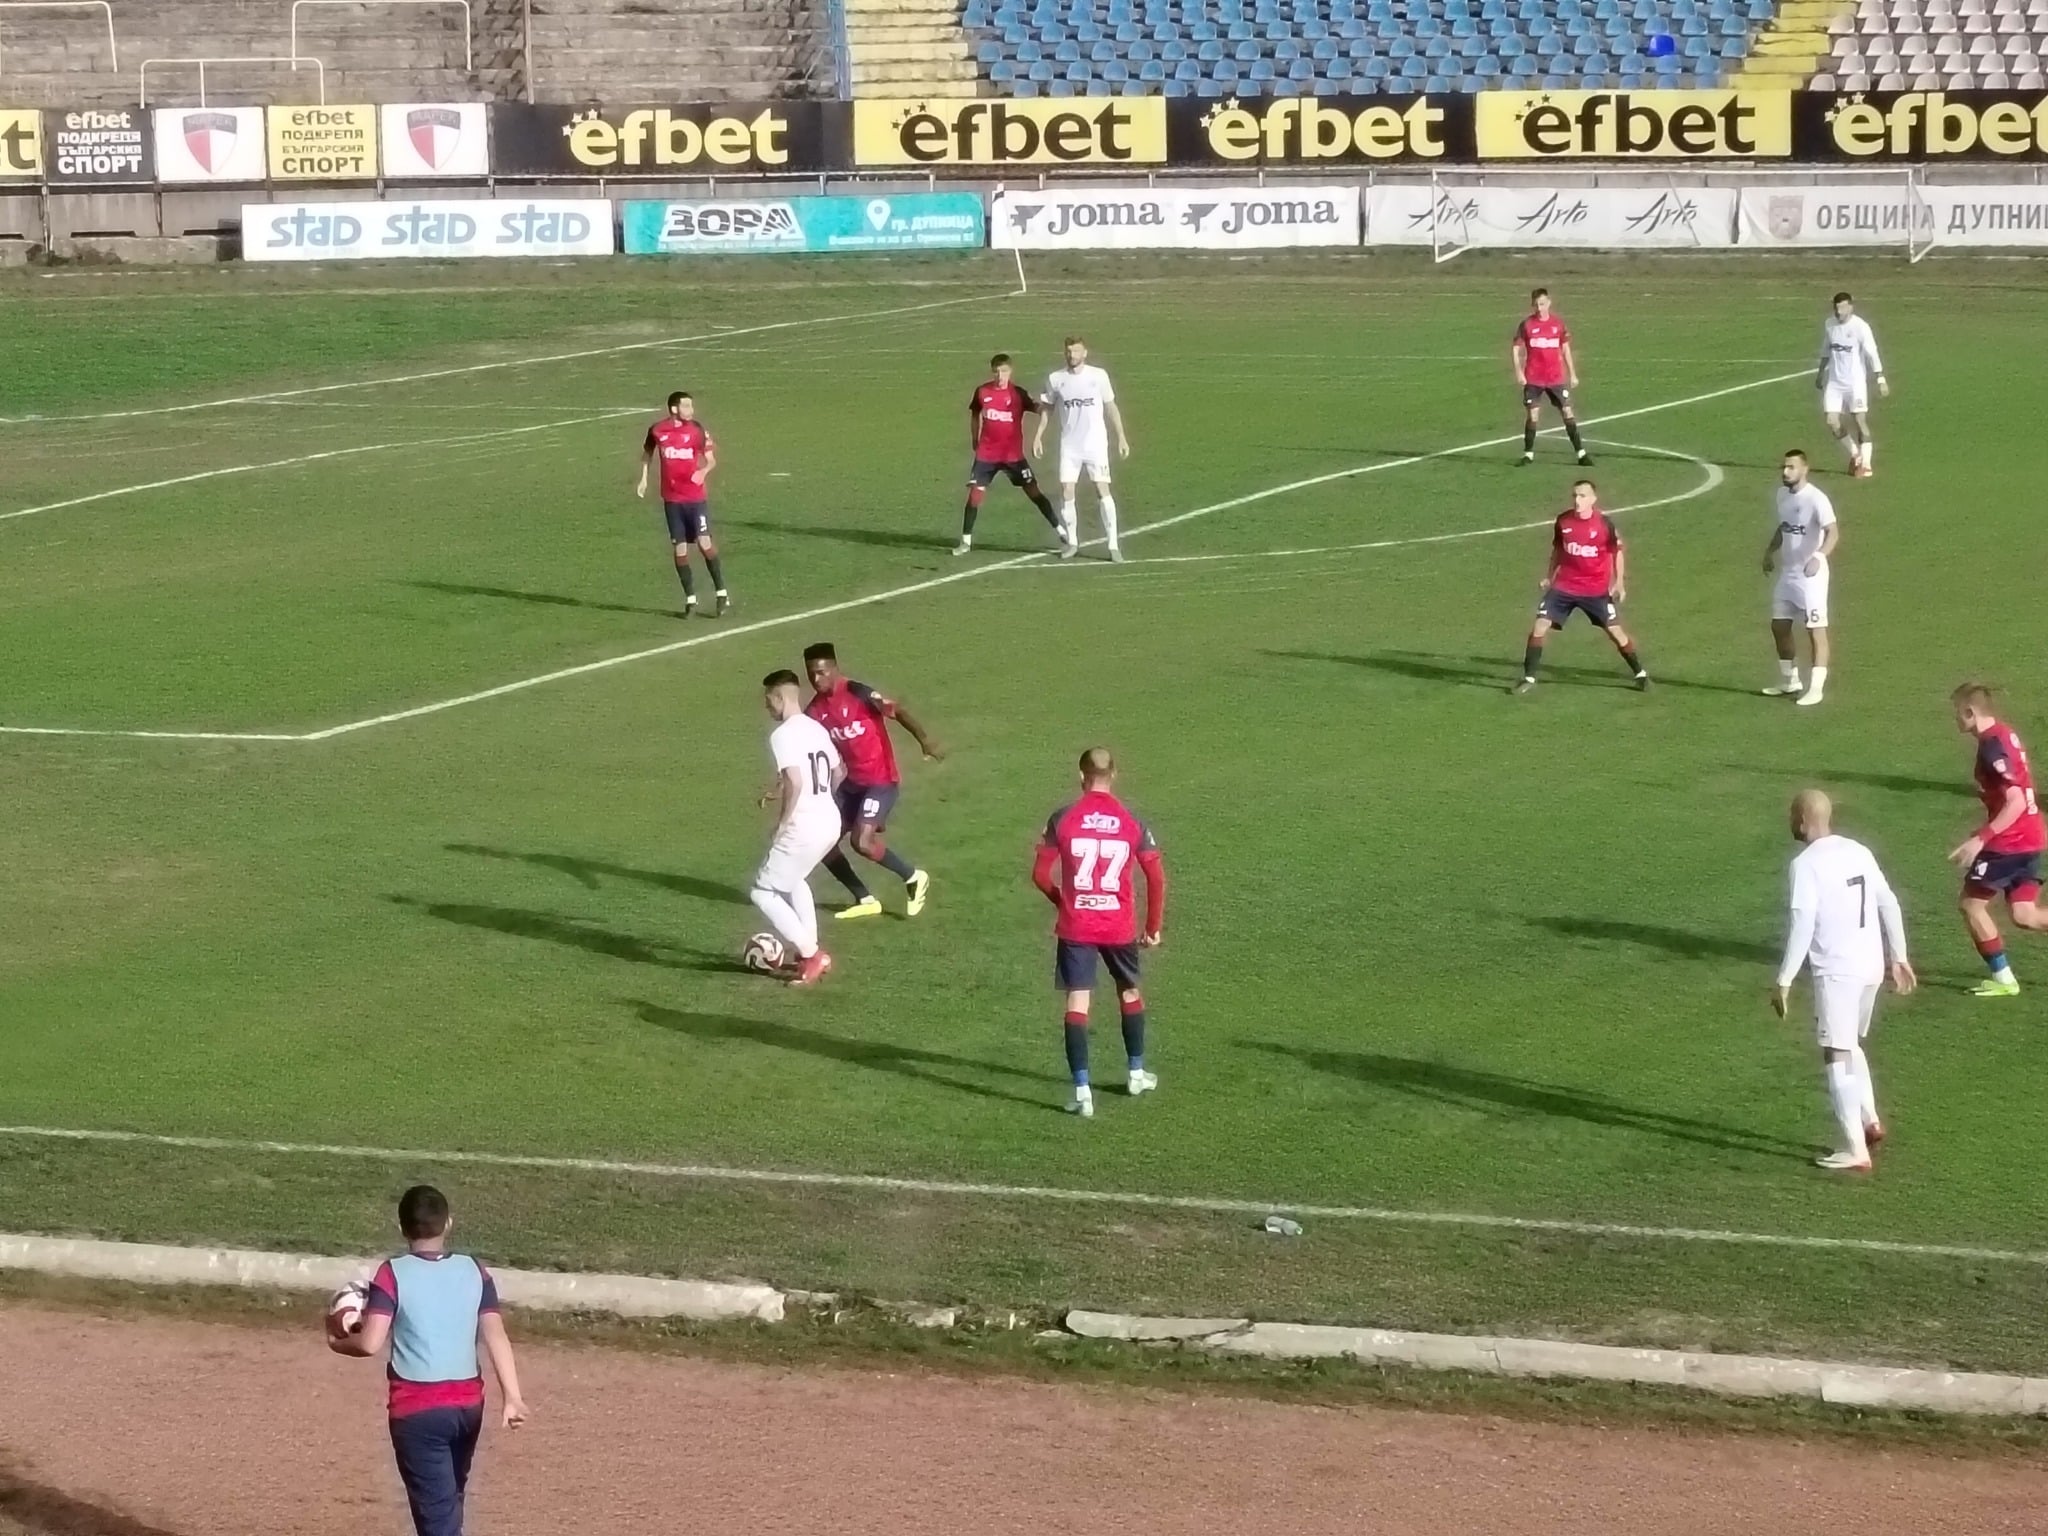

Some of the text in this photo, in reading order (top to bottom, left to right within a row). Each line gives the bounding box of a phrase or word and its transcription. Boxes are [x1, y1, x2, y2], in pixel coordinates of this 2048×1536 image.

[65, 111, 131, 129] efbet
[282, 129, 364, 141] ПОДКРЕПЯ
[292, 110, 354, 125] efbet
[900, 102, 1132, 161] efbet
[1208, 96, 1445, 160] efbet
[1522, 94, 1756, 154] efbet
[57, 131, 142, 145] ПОДКРЕПЯ
[570, 108, 788, 166] efbet
[57, 155, 142, 174] СПОРТ
[282, 157, 364, 173] СПОРТ
[911, 215, 974, 231] ДУПНИЦА
[1047, 201, 1165, 236] Joma
[1221, 199, 1339, 234] Joma
[1816, 204, 2048, 234] ОБЩИНА ДУПНИ
[808, 750, 831, 795] 10
[1070, 837, 1131, 892] 77
[1846, 874, 1866, 929] 7
